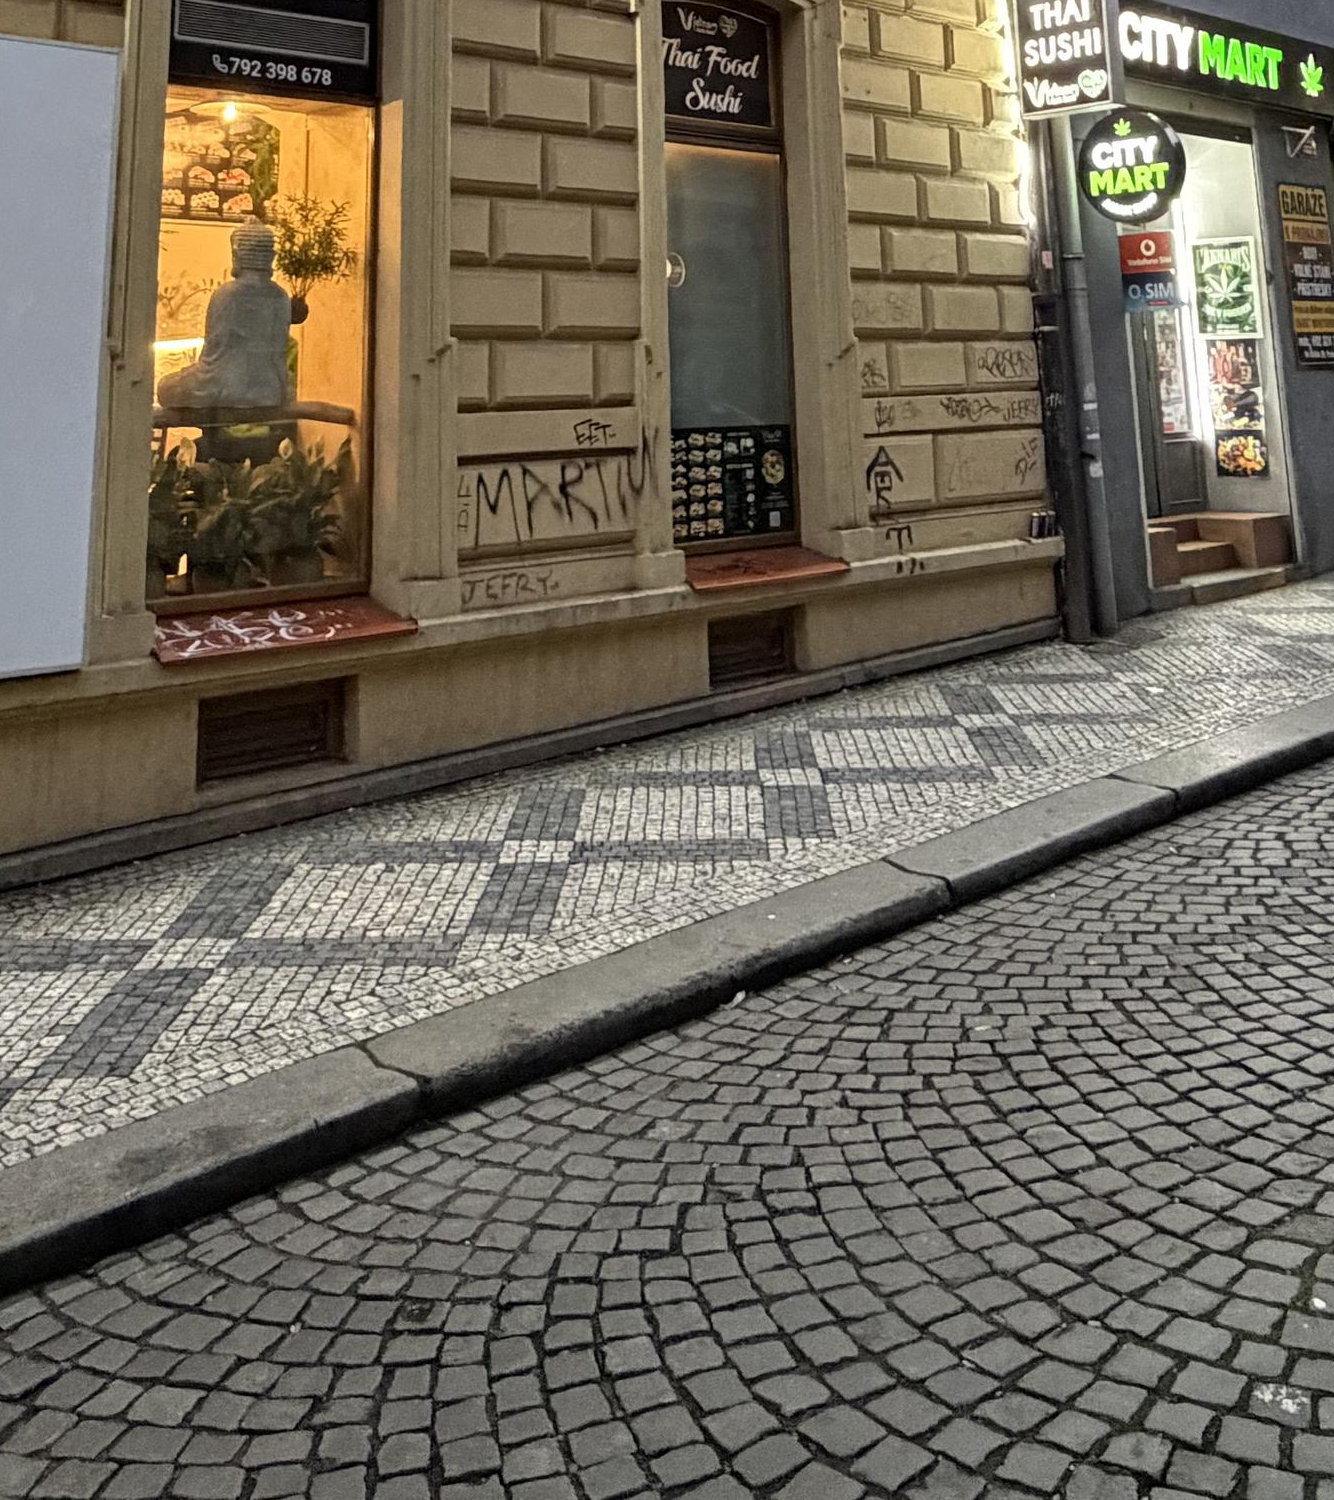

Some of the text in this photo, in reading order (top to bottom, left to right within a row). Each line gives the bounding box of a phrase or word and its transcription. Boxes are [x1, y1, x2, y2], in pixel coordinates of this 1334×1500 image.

[661, 37, 760, 79] Thai Food
[1024, 26, 1102, 67] SUSHI
[1118, 10, 1283, 90] CITY MART
[228, 57, 332, 86] 792 398 678
[685, 77, 744, 114] Sushi
[1091, 135, 1158, 169] CITY
[1089, 162, 1169, 197] MART
[1145, 282, 1174, 299] SIM
